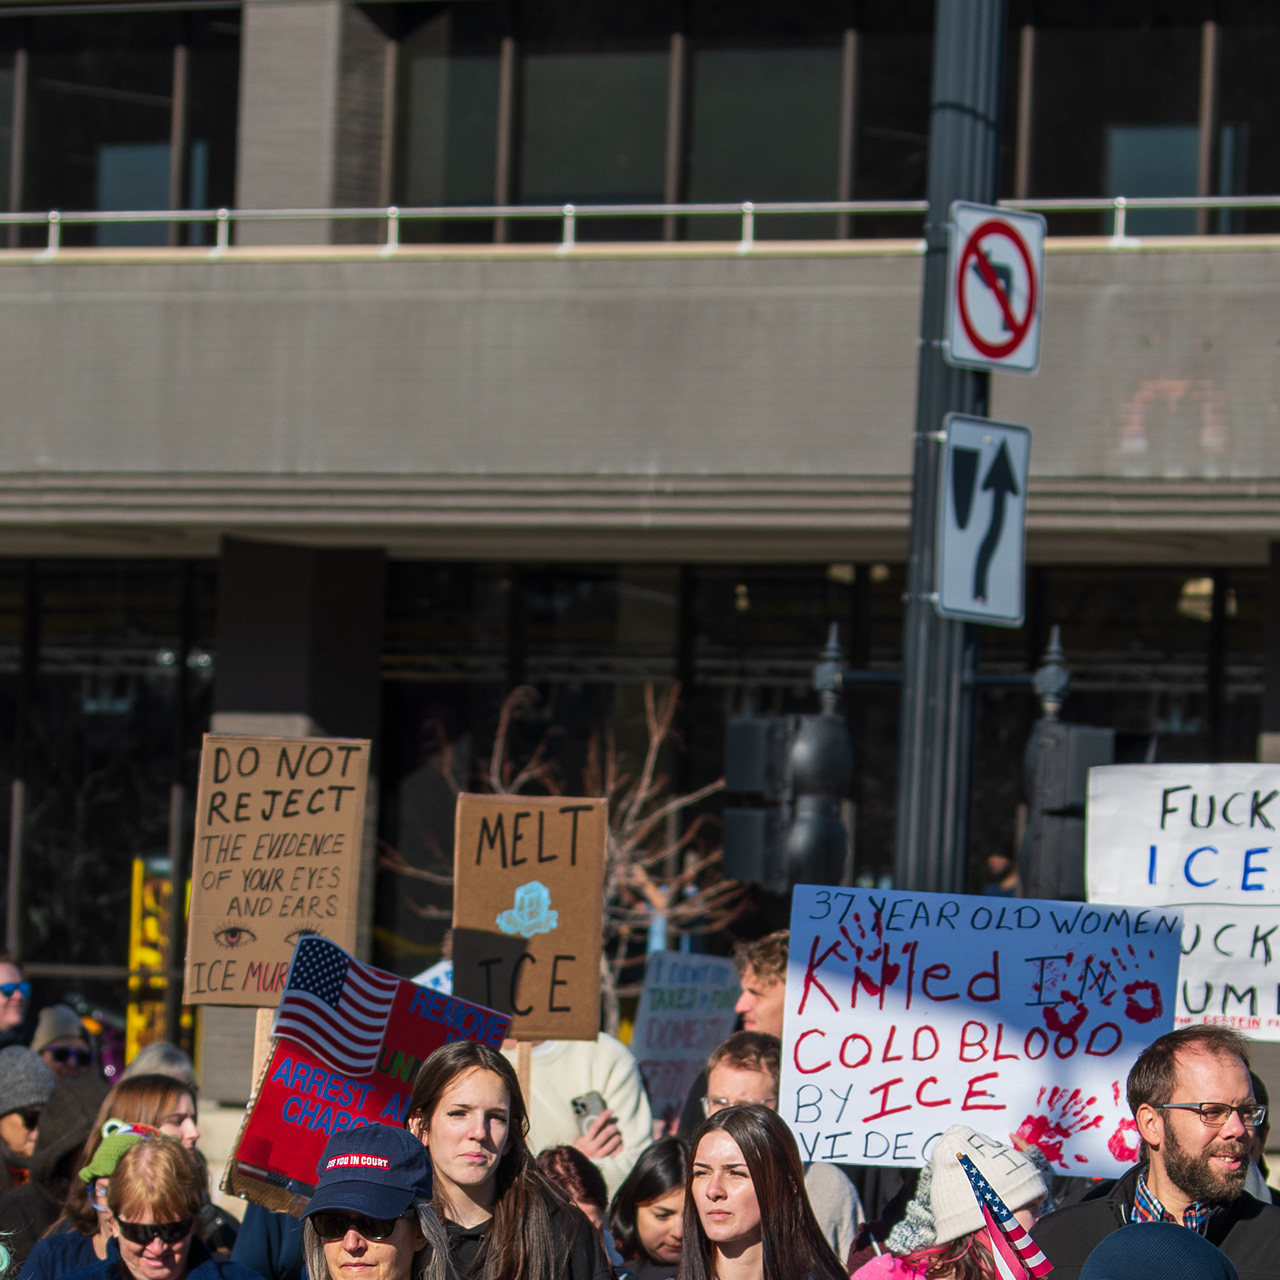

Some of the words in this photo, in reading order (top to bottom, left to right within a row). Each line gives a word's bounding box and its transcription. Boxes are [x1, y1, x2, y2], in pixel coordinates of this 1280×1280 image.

[213, 746, 260, 784] DO
[276, 744, 362, 780] NOT
[206, 785, 356, 827] REJECT
[1160, 785, 1280, 831] FUCK
[201, 833, 247, 864] THE
[251, 832, 346, 862] EVIDENCE
[475, 804, 596, 869] MELT
[201, 868, 233, 891] OF
[241, 866, 284, 893] YOUR
[289, 865, 341, 892] EYES
[226, 896, 273, 918] AND
[278, 894, 339, 919] EARS
[808, 889, 856, 925] 37
[868, 894, 961, 932] YEAR
[970, 905, 1043, 931] OLD
[1049, 907, 1180, 938] WOMEN
[1181, 923, 1280, 967] UCK
[190, 959, 237, 995] ICE
[477, 951, 577, 1017] ICE
[1023, 954, 1112, 1008] IN
[408, 986, 509, 1047] REMOVE
[793, 1024, 942, 1074] COLD
[958, 1020, 1124, 1063] BLOOD
[271, 1057, 376, 1112] ARREST
[795, 1083, 854, 1124] BY
[862, 1072, 1008, 1124] ICE
[336, 1156, 349, 1166] YOU
[350, 1155, 360, 1165] IN
[360, 1155, 389, 1168] COURT
